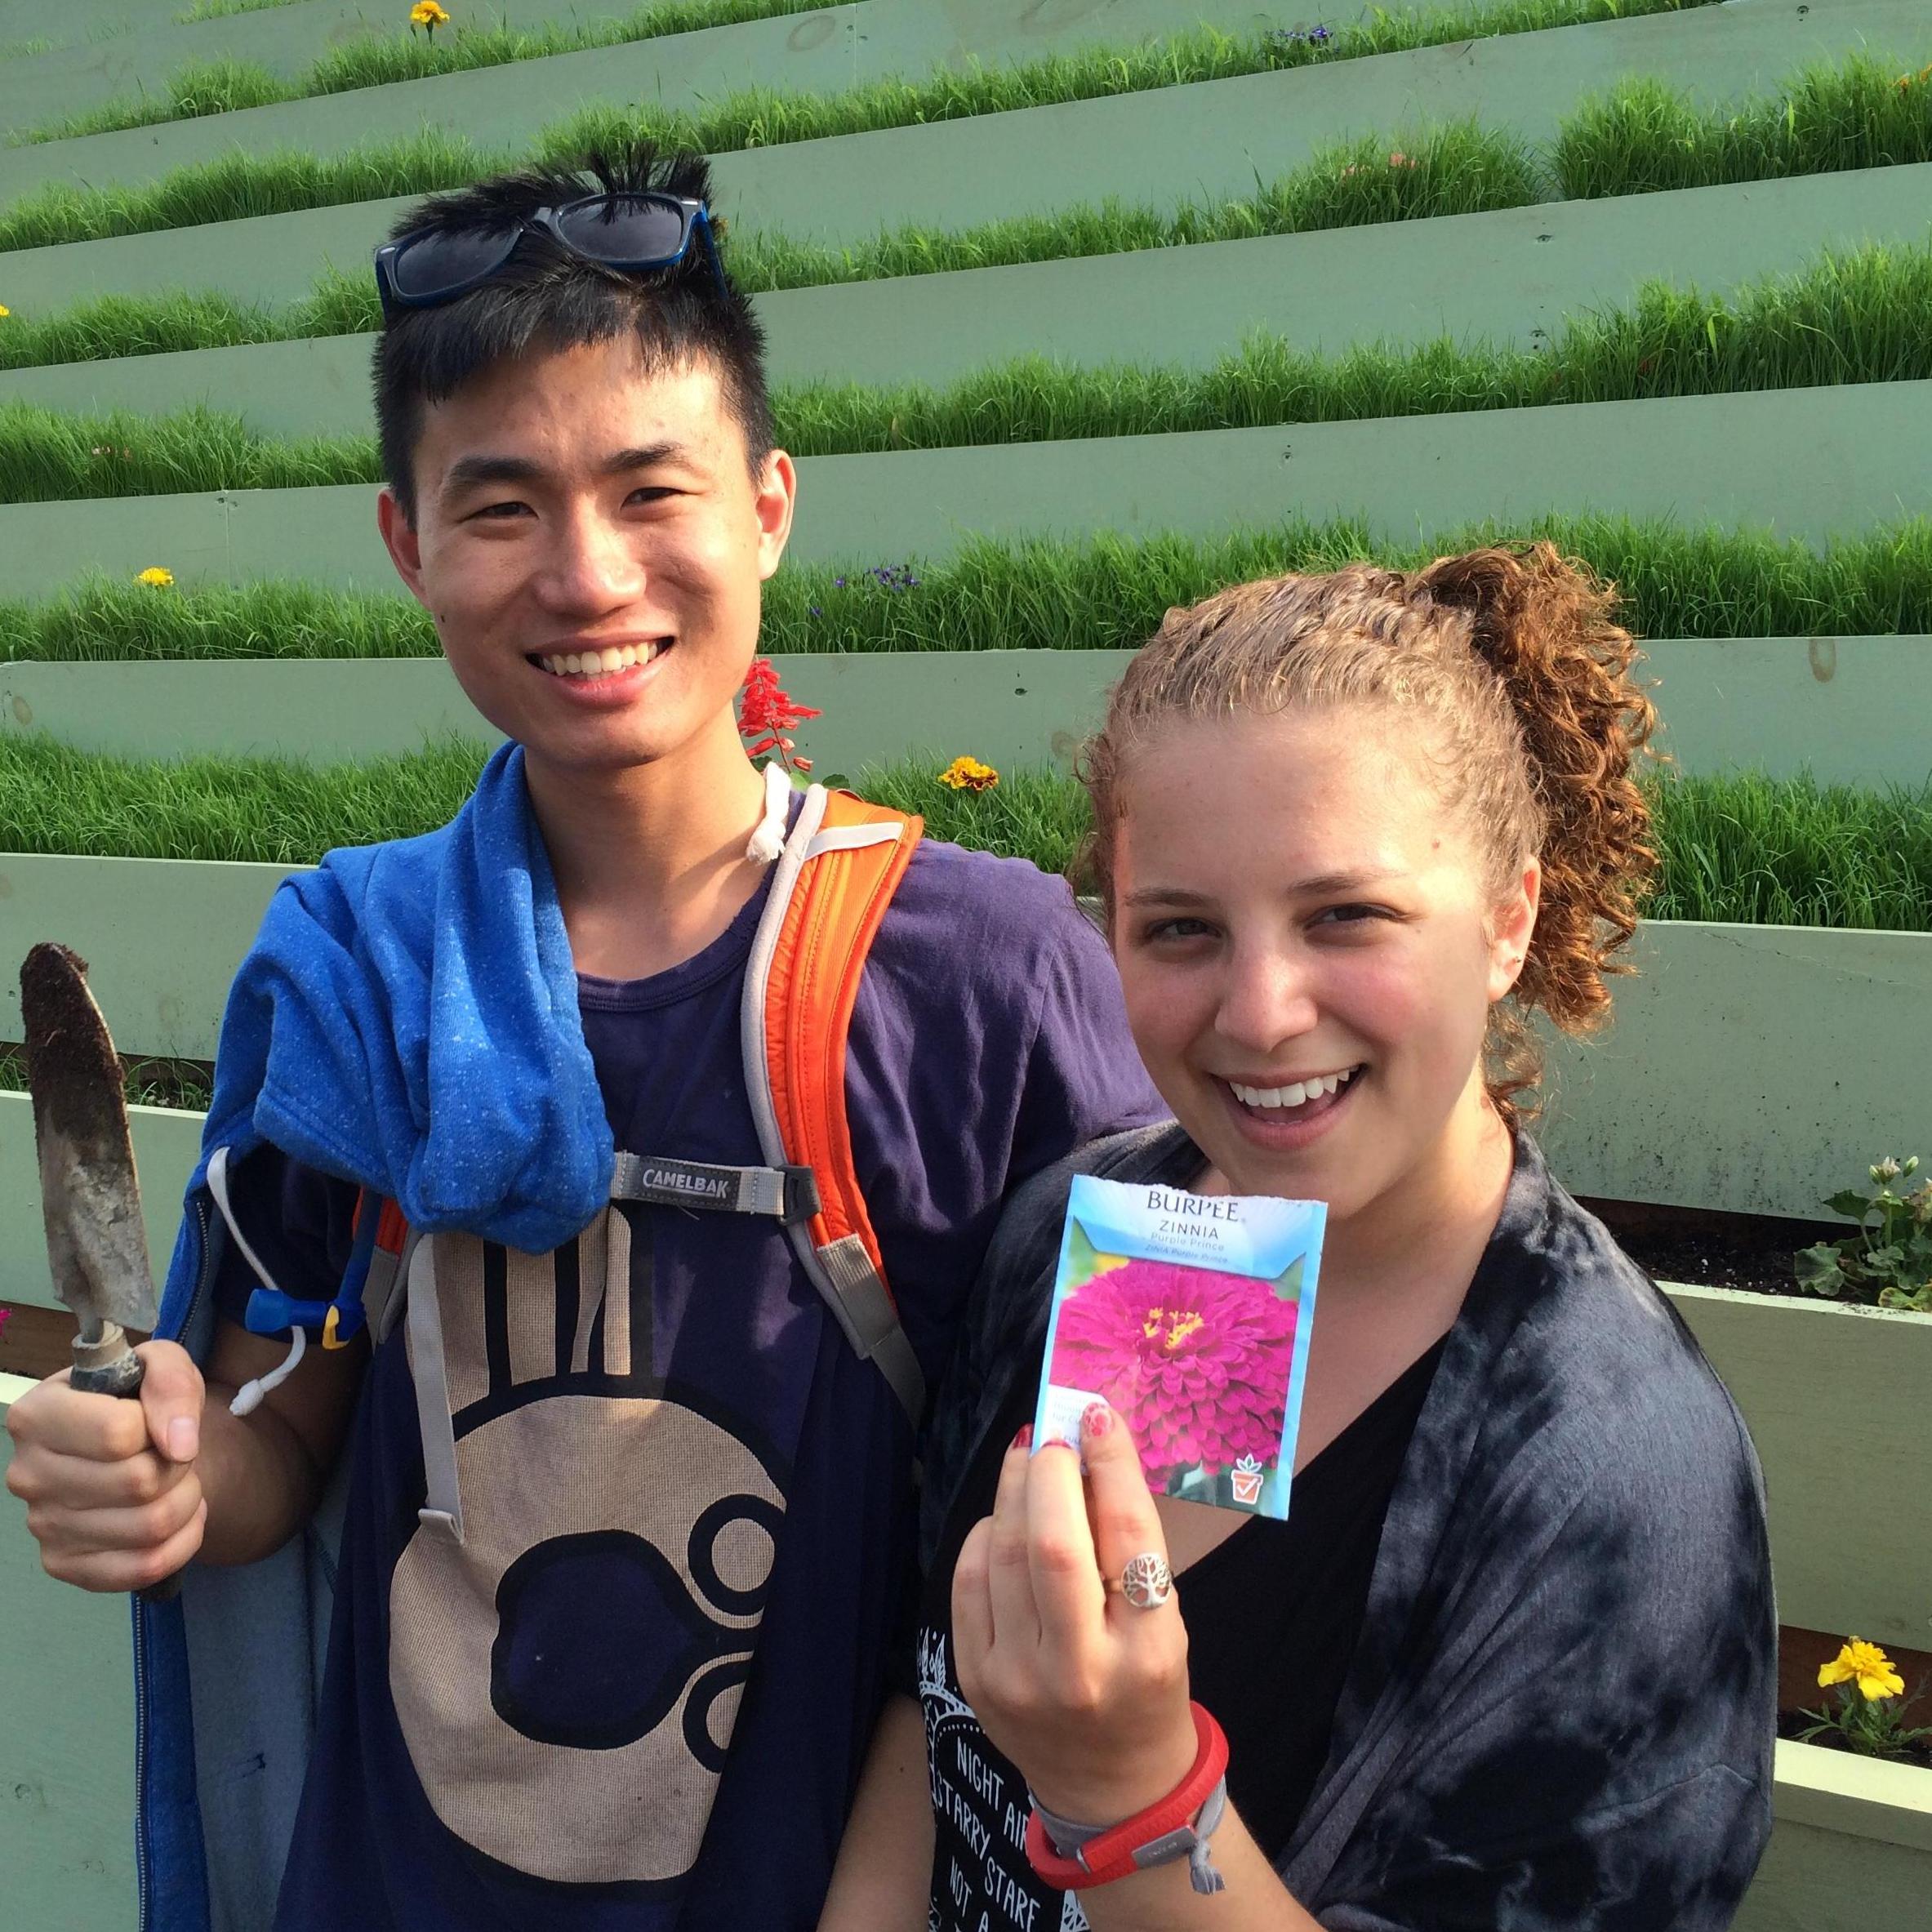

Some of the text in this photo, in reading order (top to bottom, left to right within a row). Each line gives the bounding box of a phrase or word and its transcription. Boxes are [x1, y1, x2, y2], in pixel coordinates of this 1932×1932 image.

[643, 1169, 729, 1199] CAMELBAK
[1147, 1191, 1239, 1222] BURPEE
[1151, 1232, 1225, 1252] Purple Prince
[1159, 1219, 1219, 1240] ZINNIA
[957, 1736, 1004, 1811] NIGHT
[937, 1770, 990, 1860] STARRY
[950, 1854, 973, 1917] NOT
